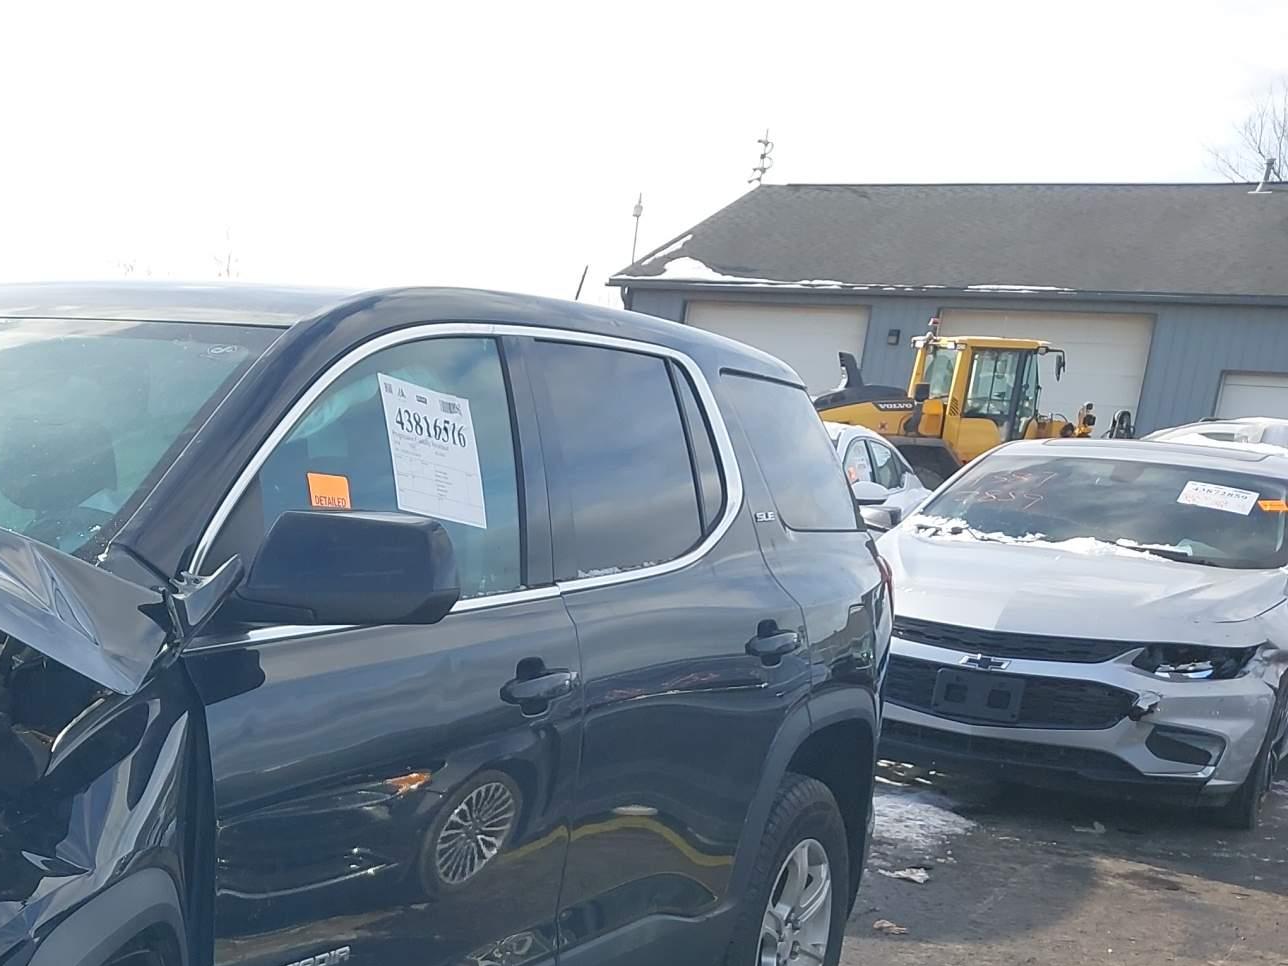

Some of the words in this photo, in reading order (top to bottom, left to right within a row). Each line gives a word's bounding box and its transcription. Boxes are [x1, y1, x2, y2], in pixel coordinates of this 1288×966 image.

[395, 407, 467, 448] 43816516
[314, 495, 347, 508] DETAILED
[755, 511, 776, 522] SLE
